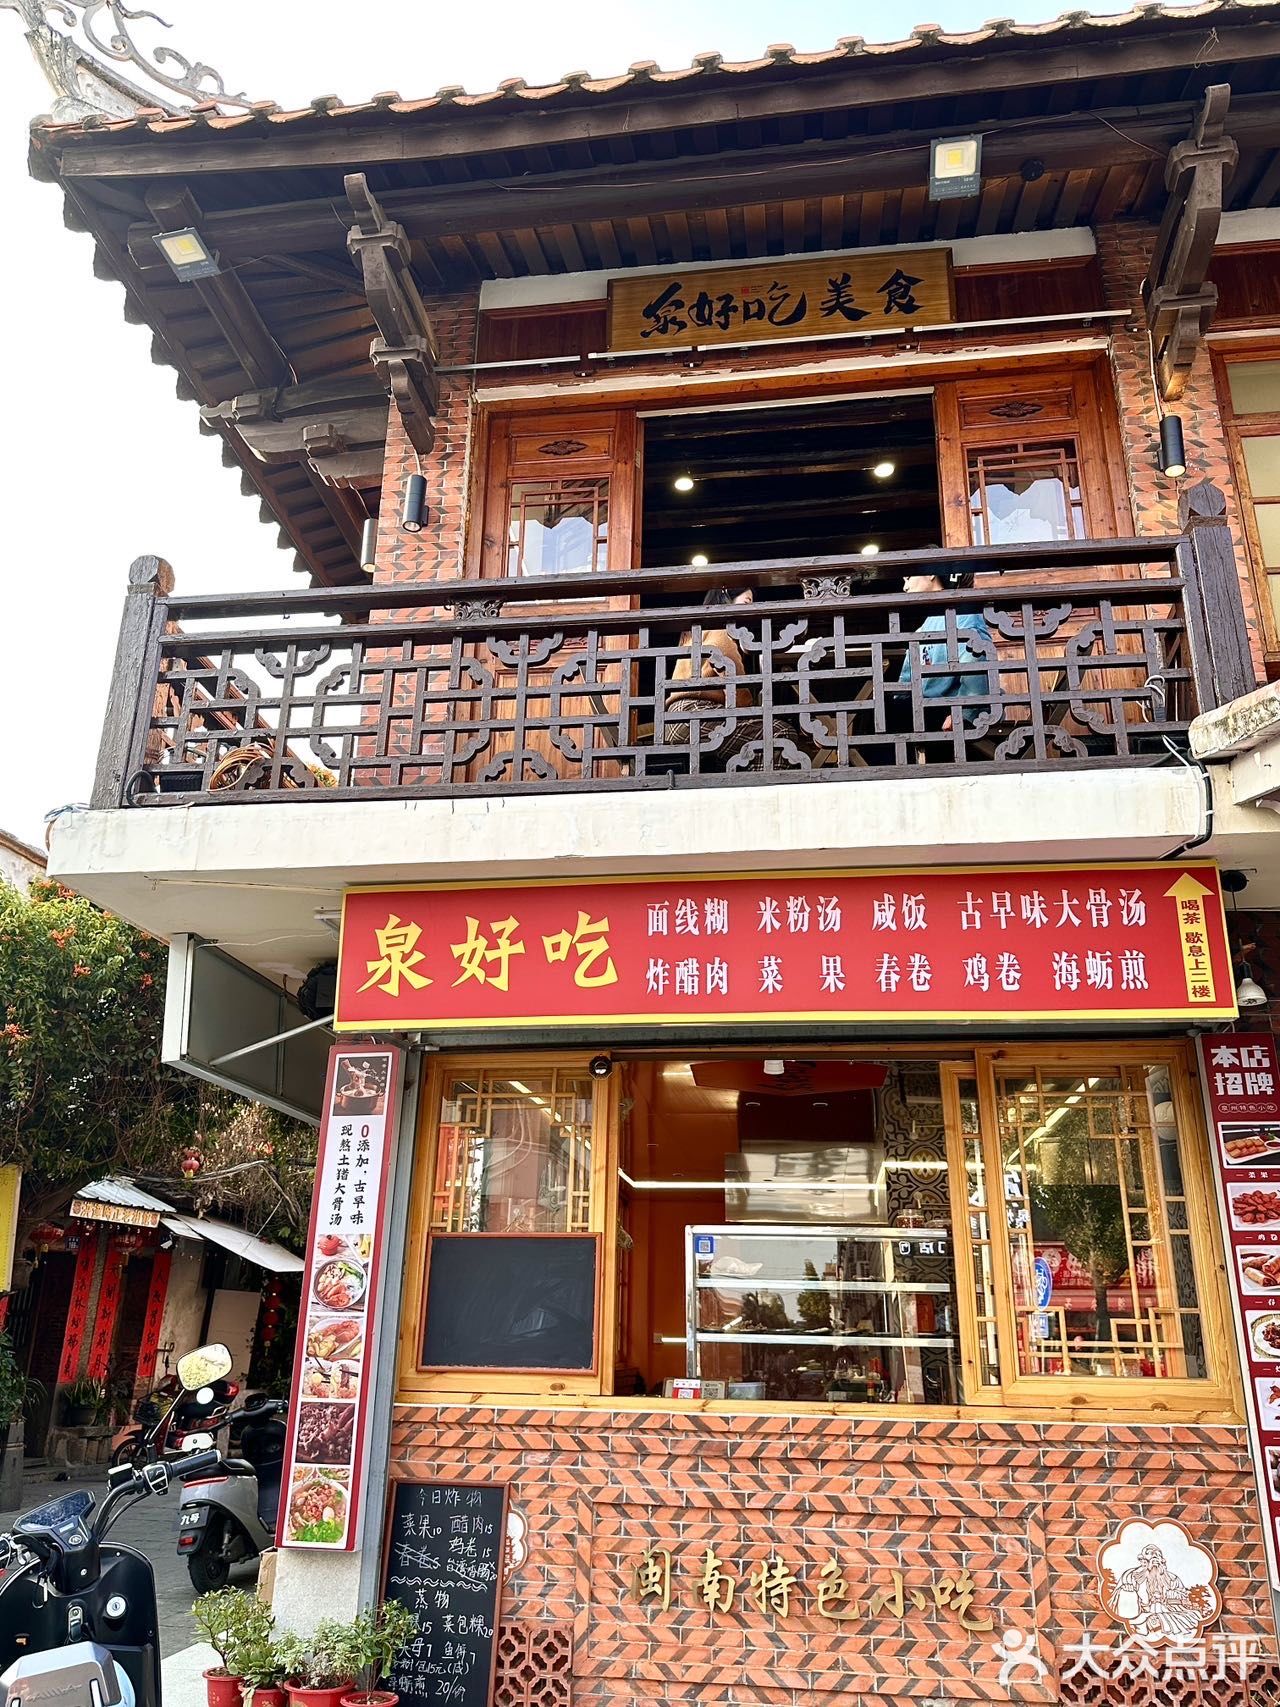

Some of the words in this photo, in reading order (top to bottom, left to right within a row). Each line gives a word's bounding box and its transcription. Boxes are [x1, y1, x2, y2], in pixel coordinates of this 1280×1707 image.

[646, 897, 729, 937] 面线糊
[756, 894, 843, 934] 米粉汤
[871, 892, 929, 932] 咸饭
[957, 887, 1148, 931] 古早味大骨汤
[356, 910, 619, 998] 泉好吃
[645, 956, 729, 997] 炸醋肉
[875, 952, 934, 994] 春卷
[962, 952, 1022, 993] 鸡卷
[1052, 949, 1150, 993] 海蛎煎
[1210, 1045, 1271, 1068] 本店
[1213, 1072, 1275, 1096] 招牌
[329, 1124, 353, 1226] 现熬土猪大骨汤
[180, 1512, 200, 1526] 九号
[414, 1588, 450, 1610] 蒸物
[630, 1547, 994, 1633] 闽南特色小吃
